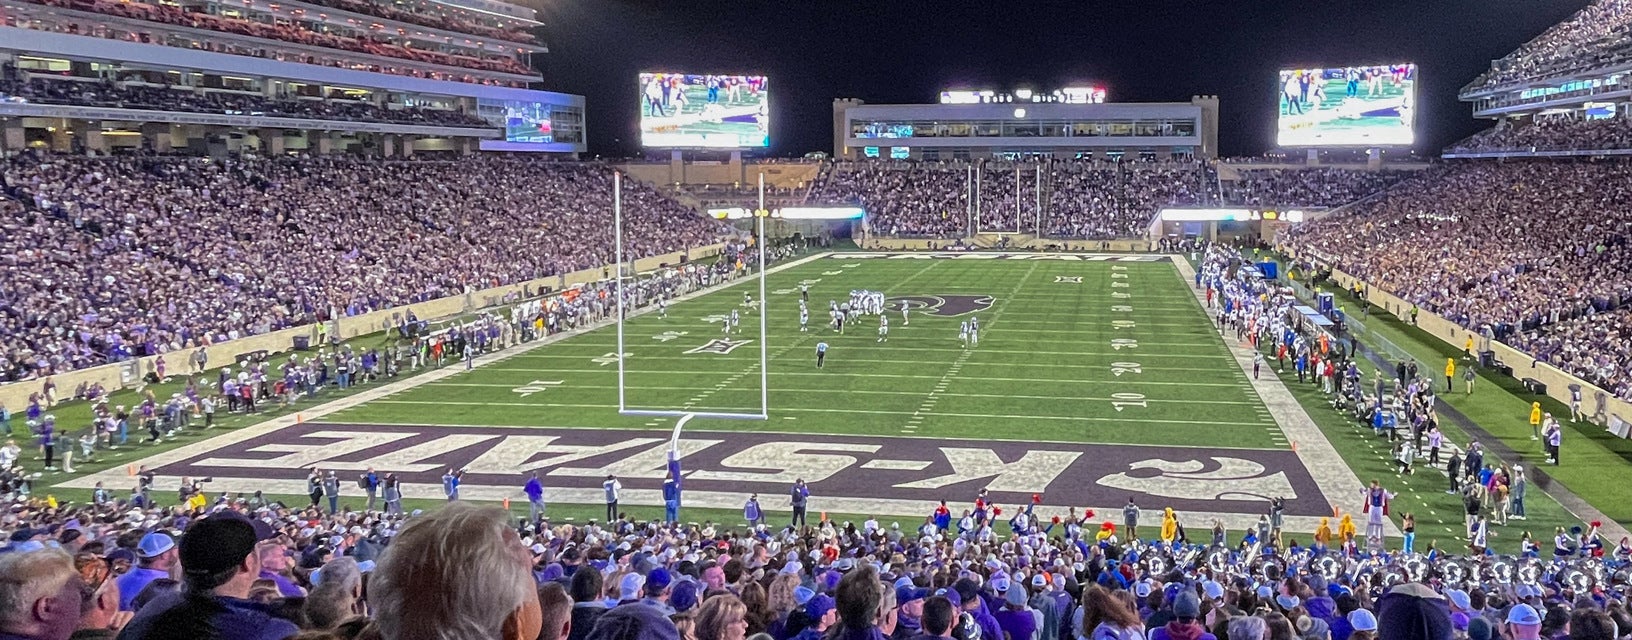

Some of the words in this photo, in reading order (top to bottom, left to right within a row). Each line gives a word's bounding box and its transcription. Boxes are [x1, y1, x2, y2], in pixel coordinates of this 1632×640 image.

[1111, 362, 1142, 374] 20
[512, 380, 565, 393] 10
[1111, 393, 1147, 408] 10
[190, 430, 1084, 493] K-STATE
